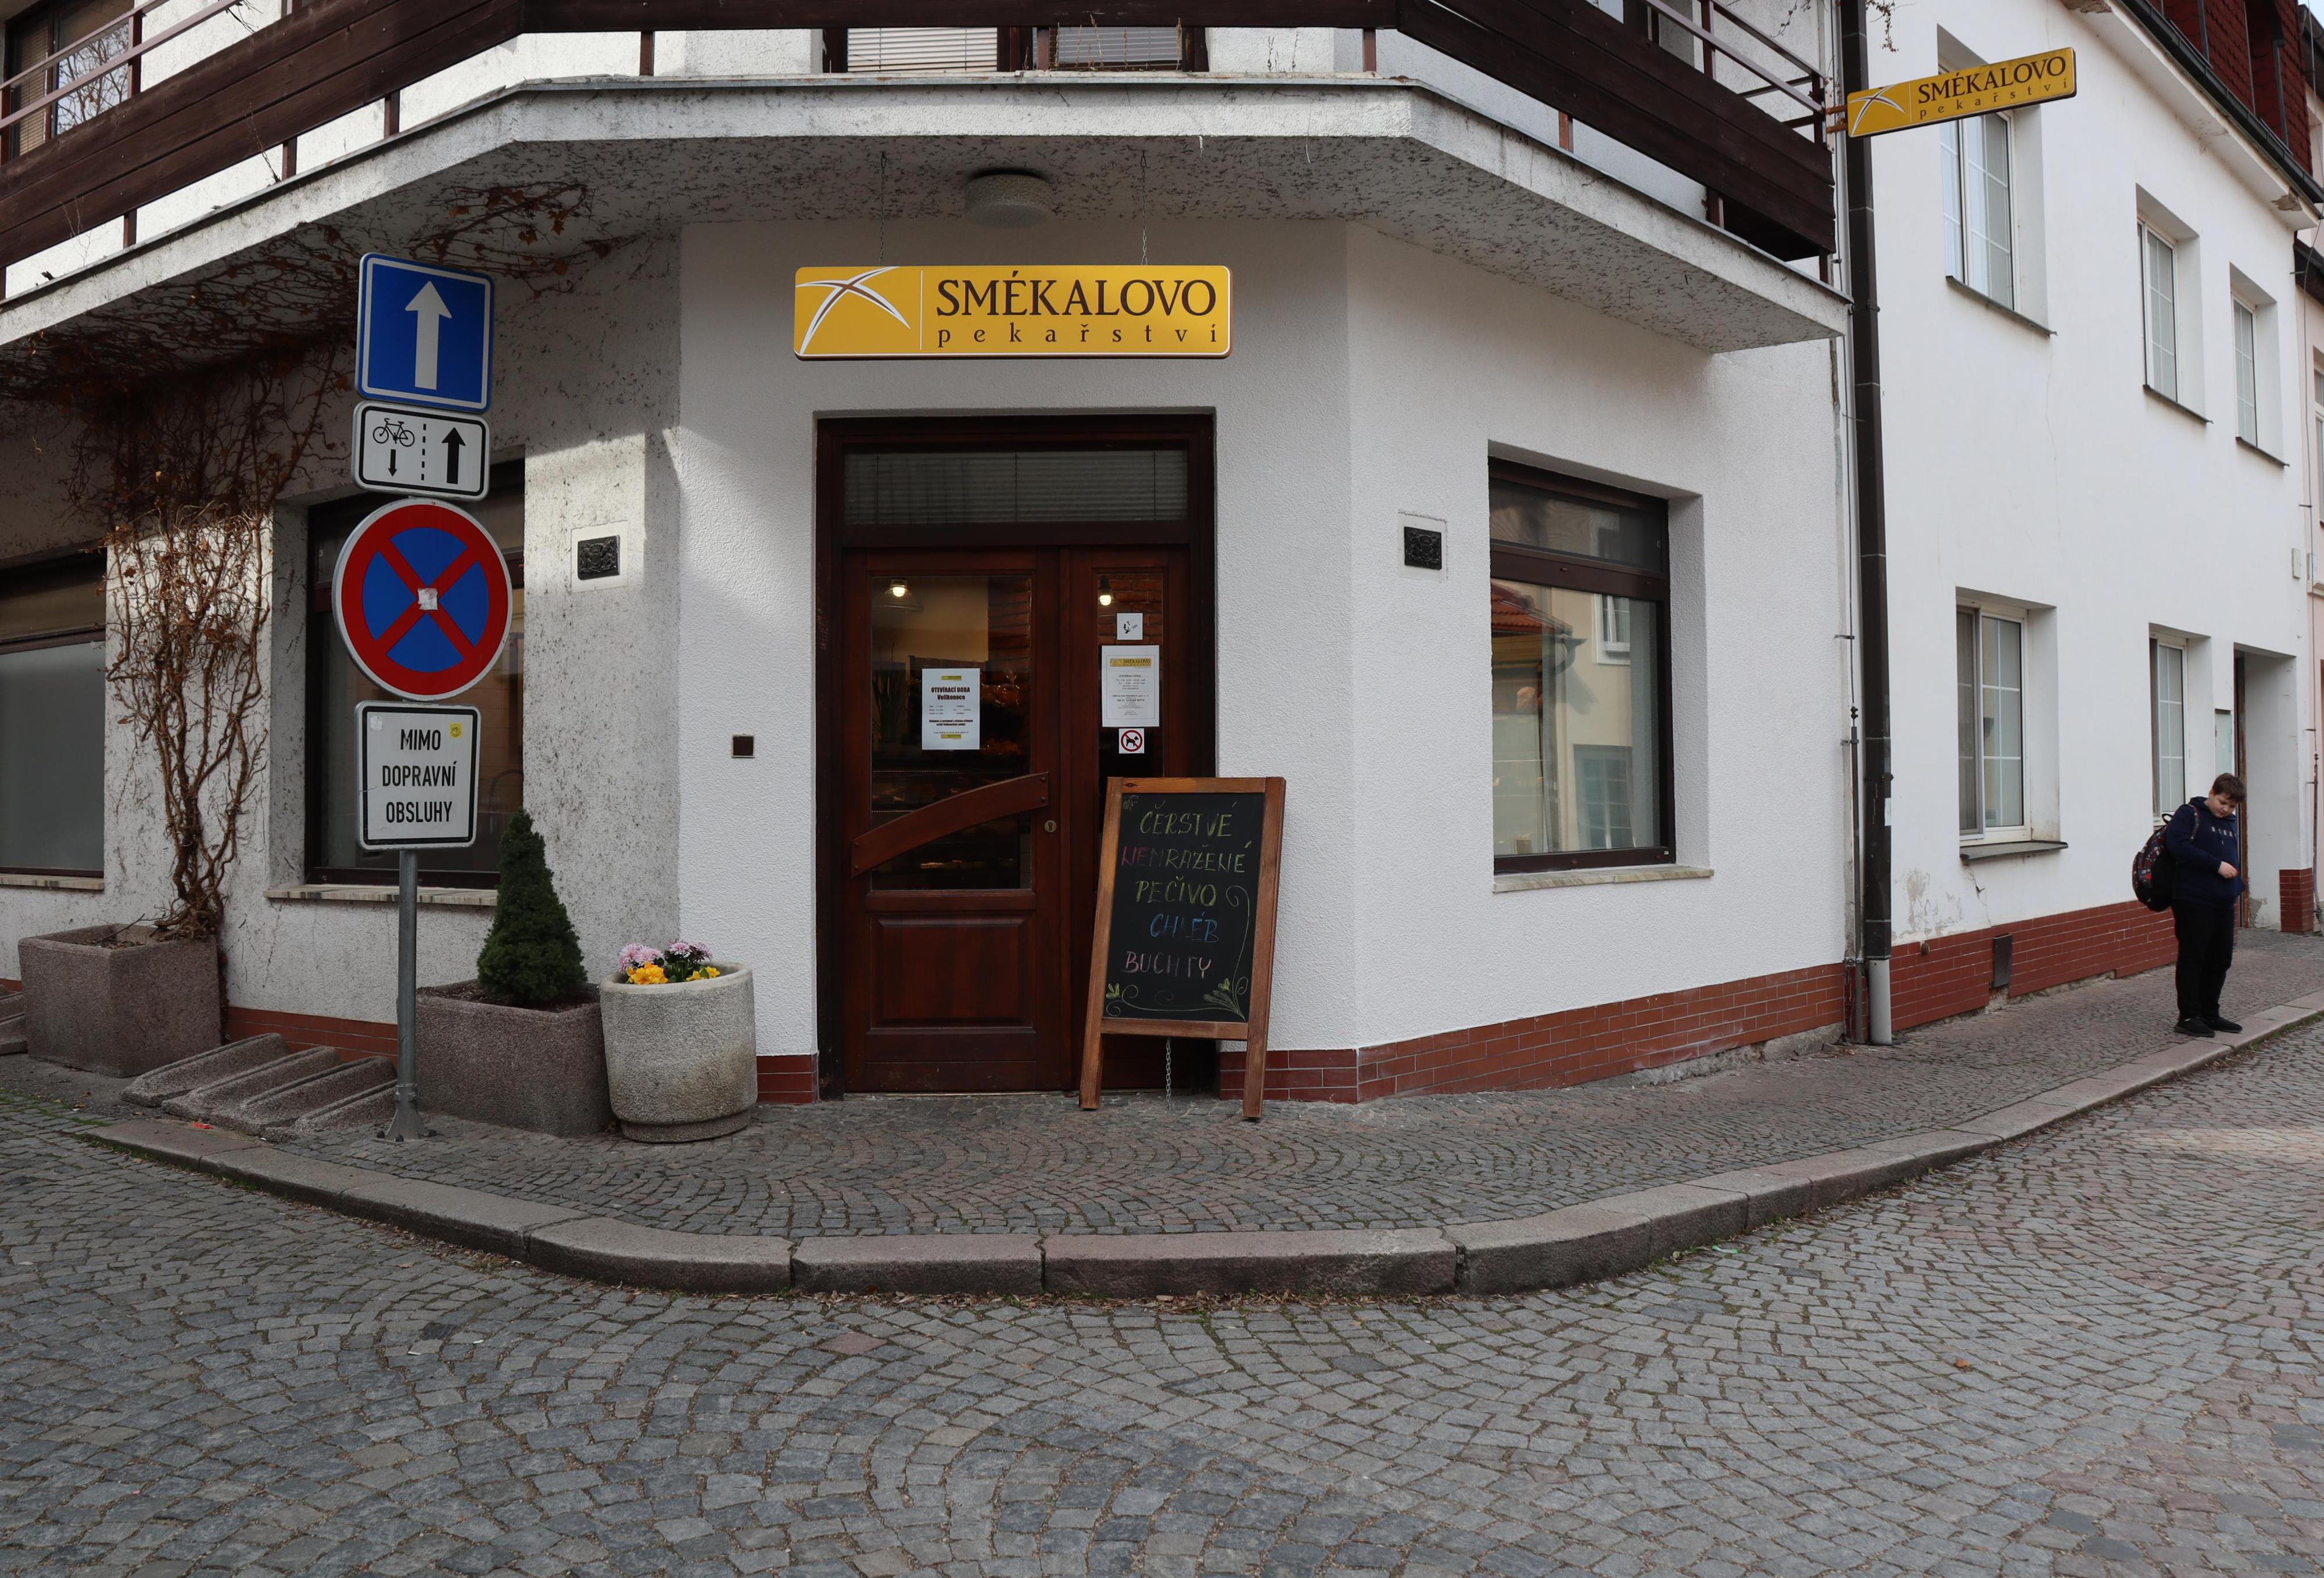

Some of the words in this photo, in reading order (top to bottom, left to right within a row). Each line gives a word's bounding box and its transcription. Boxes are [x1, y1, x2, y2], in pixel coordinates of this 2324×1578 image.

[1918, 56, 2066, 104] SMÉKALOVO
[1920, 77, 2067, 120] pekařství
[936, 270, 1216, 317] SMÉKALOVO
[938, 322, 1217, 347] pekařství
[400, 729, 442, 751] MIMO
[382, 761, 457, 787] DOPRAVNÍ
[386, 801, 453, 823] OBSLUHY
[1139, 800, 1238, 837] ČERSTVÉ
[1121, 840, 1253, 873] NEMRAŽENÉ
[1135, 876, 1217, 906] PEČIVO
[1122, 951, 1212, 980] BUCHTY
